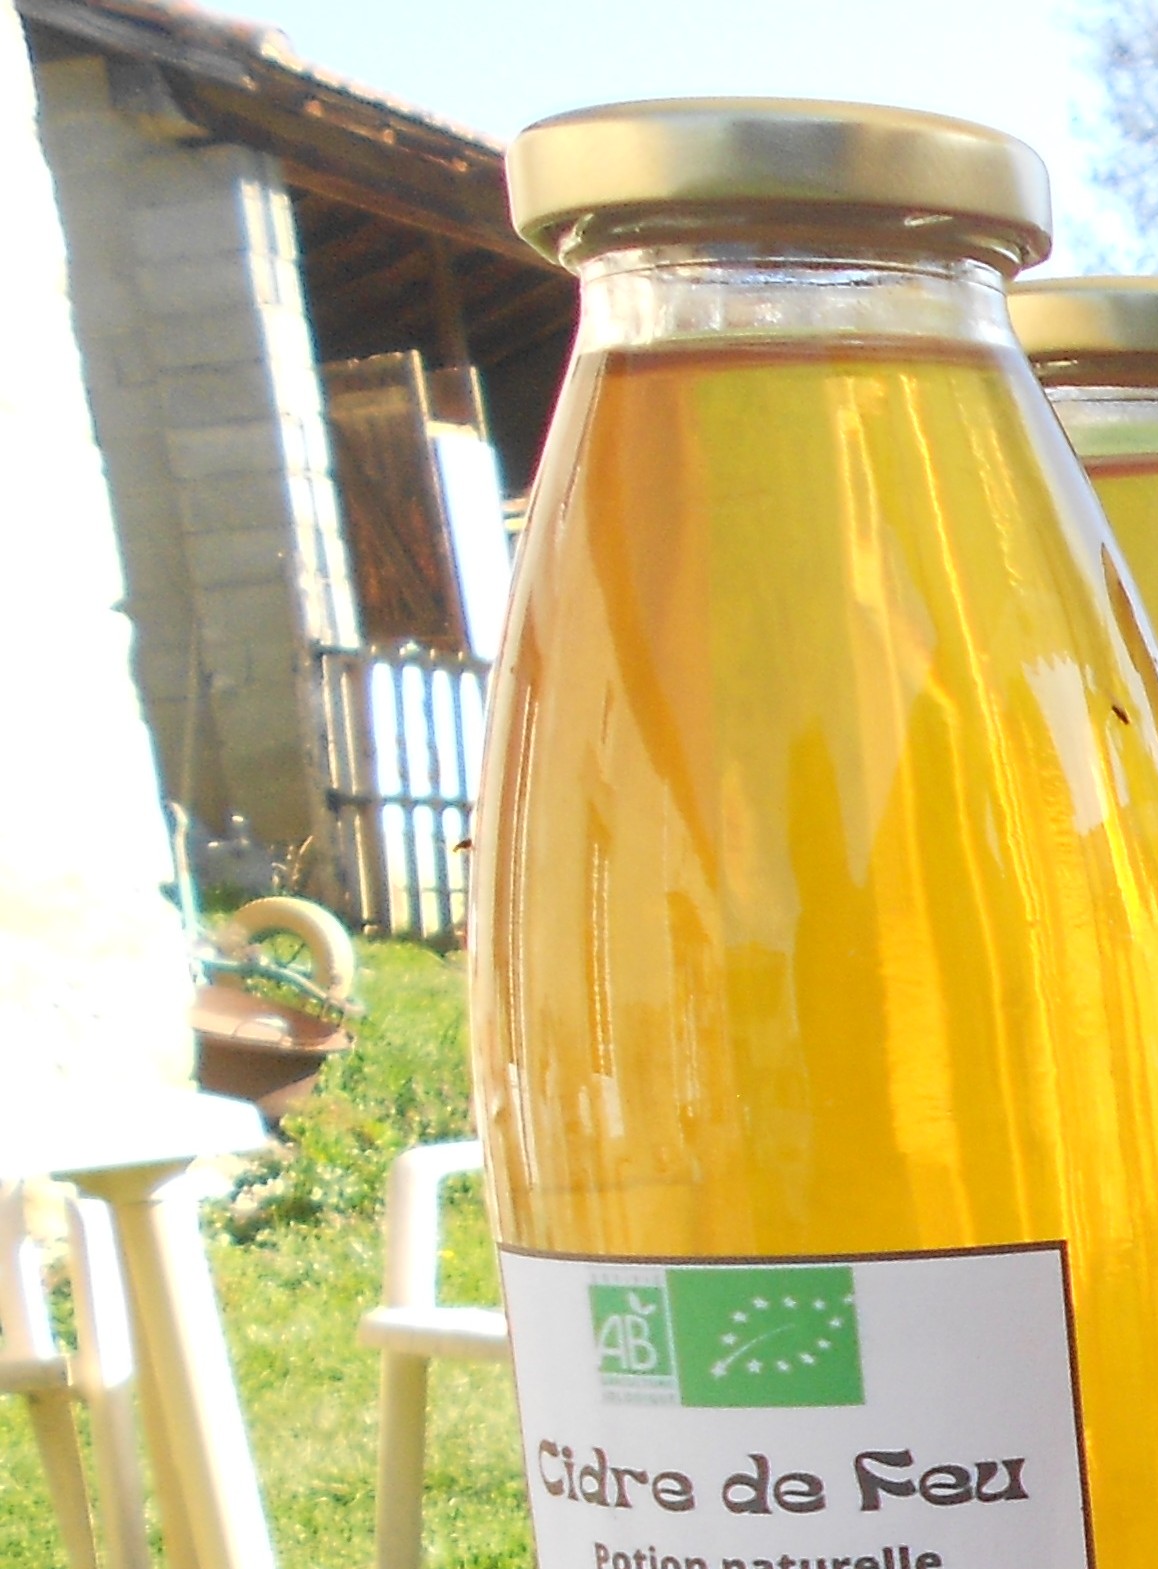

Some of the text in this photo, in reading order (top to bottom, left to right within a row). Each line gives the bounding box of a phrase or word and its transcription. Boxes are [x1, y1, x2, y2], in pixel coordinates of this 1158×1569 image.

[538, 1438, 1030, 1514] Cidre de Feu
